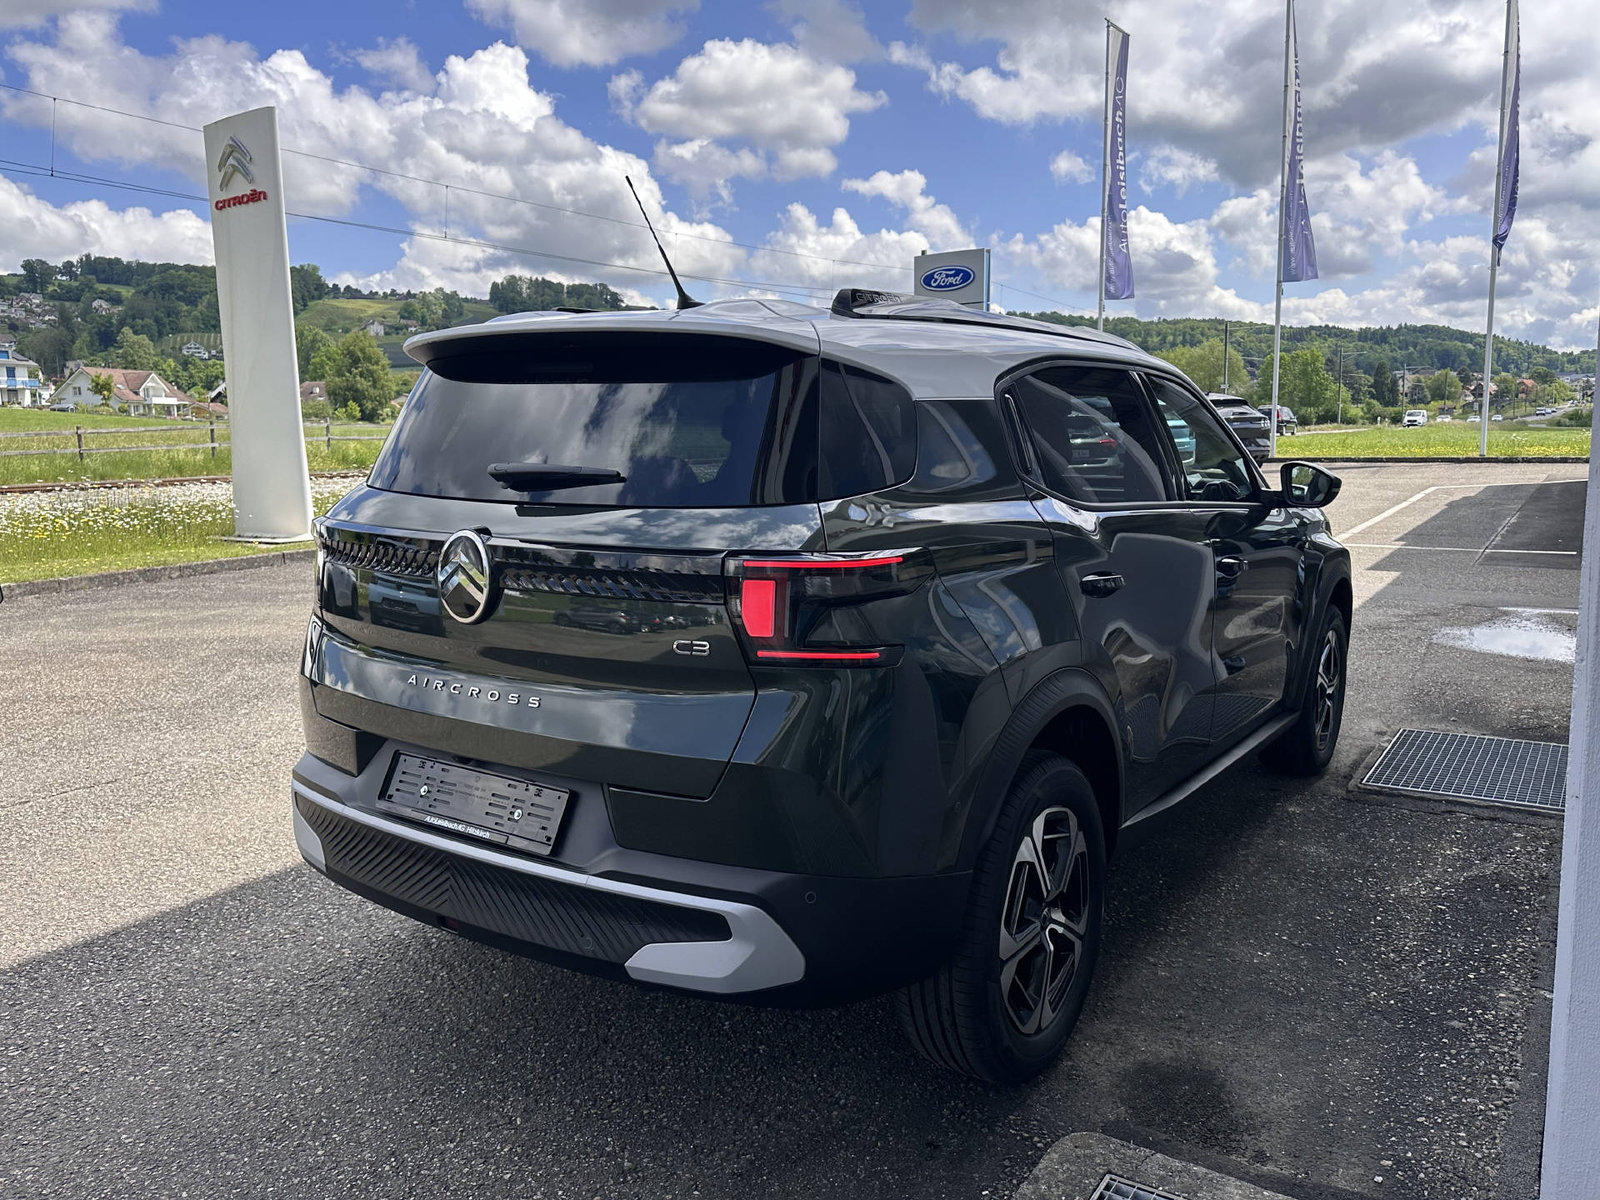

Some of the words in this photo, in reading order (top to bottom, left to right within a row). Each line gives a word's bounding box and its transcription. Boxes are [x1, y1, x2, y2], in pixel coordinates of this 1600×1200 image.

[930, 269, 964, 287] Ford
[672, 639, 710, 656] C3
[407, 674, 542, 708] AIRCROSS
